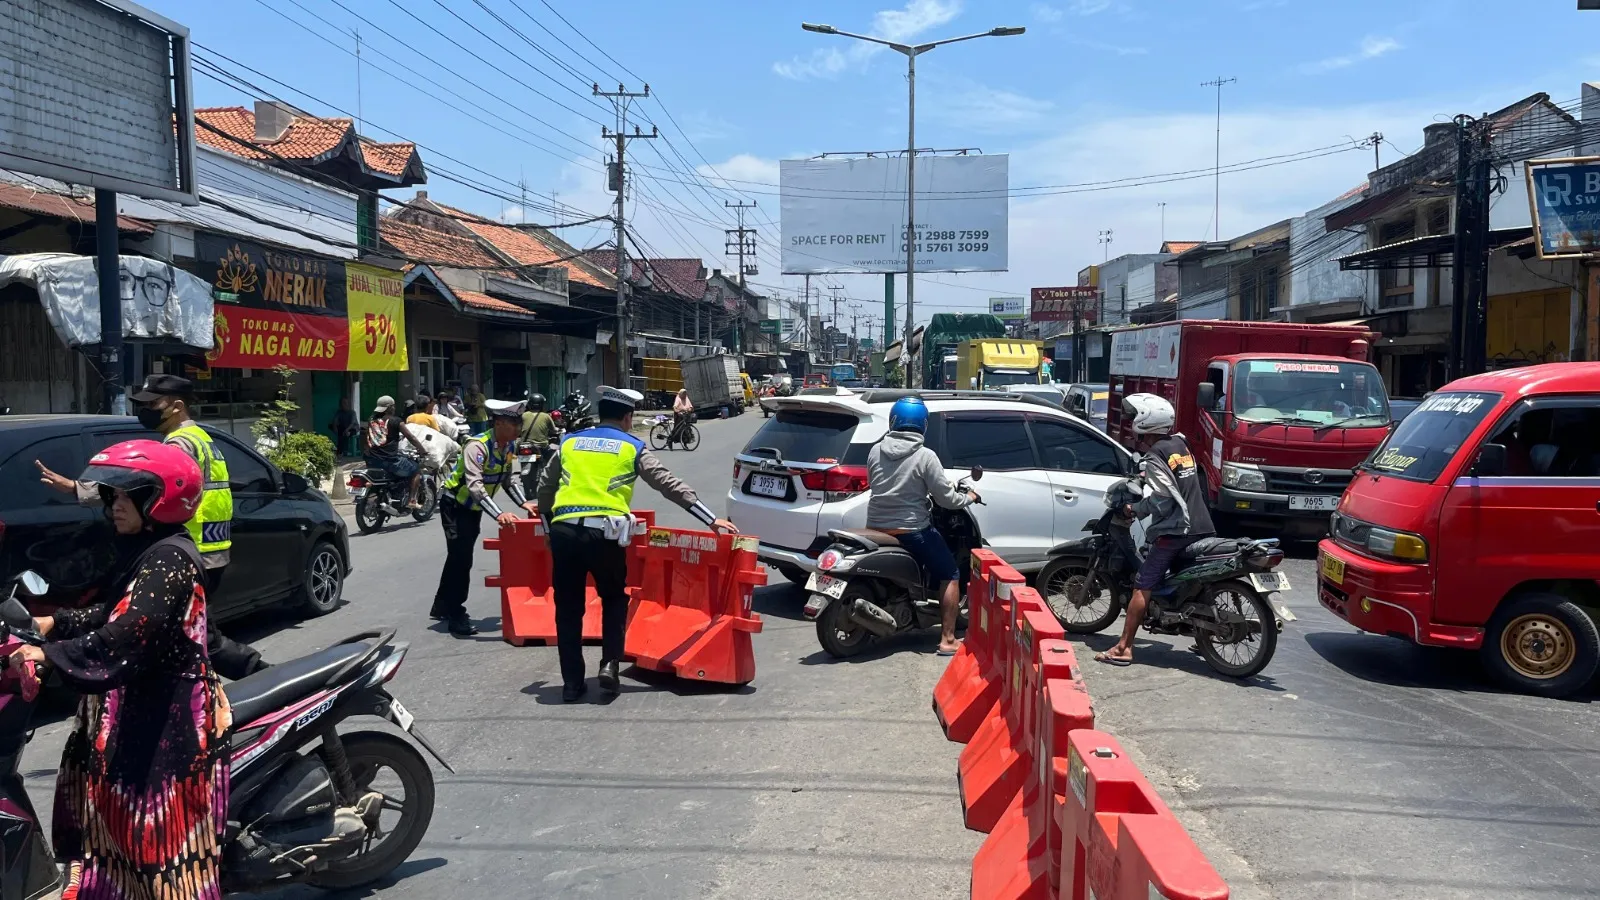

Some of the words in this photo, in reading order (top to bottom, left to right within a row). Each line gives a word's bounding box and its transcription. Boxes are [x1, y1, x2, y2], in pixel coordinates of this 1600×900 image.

[791, 235, 827, 246] SPACE
[830, 235, 853, 245] FOR
[856, 234, 886, 244] RENT
[925, 231, 956, 241] 2988
[959, 230, 989, 240] 7599
[926, 243, 953, 252] 5761
[957, 243, 989, 252] 3099
[264, 251, 300, 271] TOKO
[303, 259, 328, 276] MAS
[264, 268, 327, 308] MERAK
[350, 273, 372, 294] JUAL
[1050, 289, 1069, 298] Toko
[242, 318, 269, 331] TOKO
[272, 321, 295, 333] MAS
[364, 312, 397, 355] 5%
[239, 333, 291, 357] NAGA
[297, 337, 336, 359] MAS
[574, 438, 622, 452] POLISI
